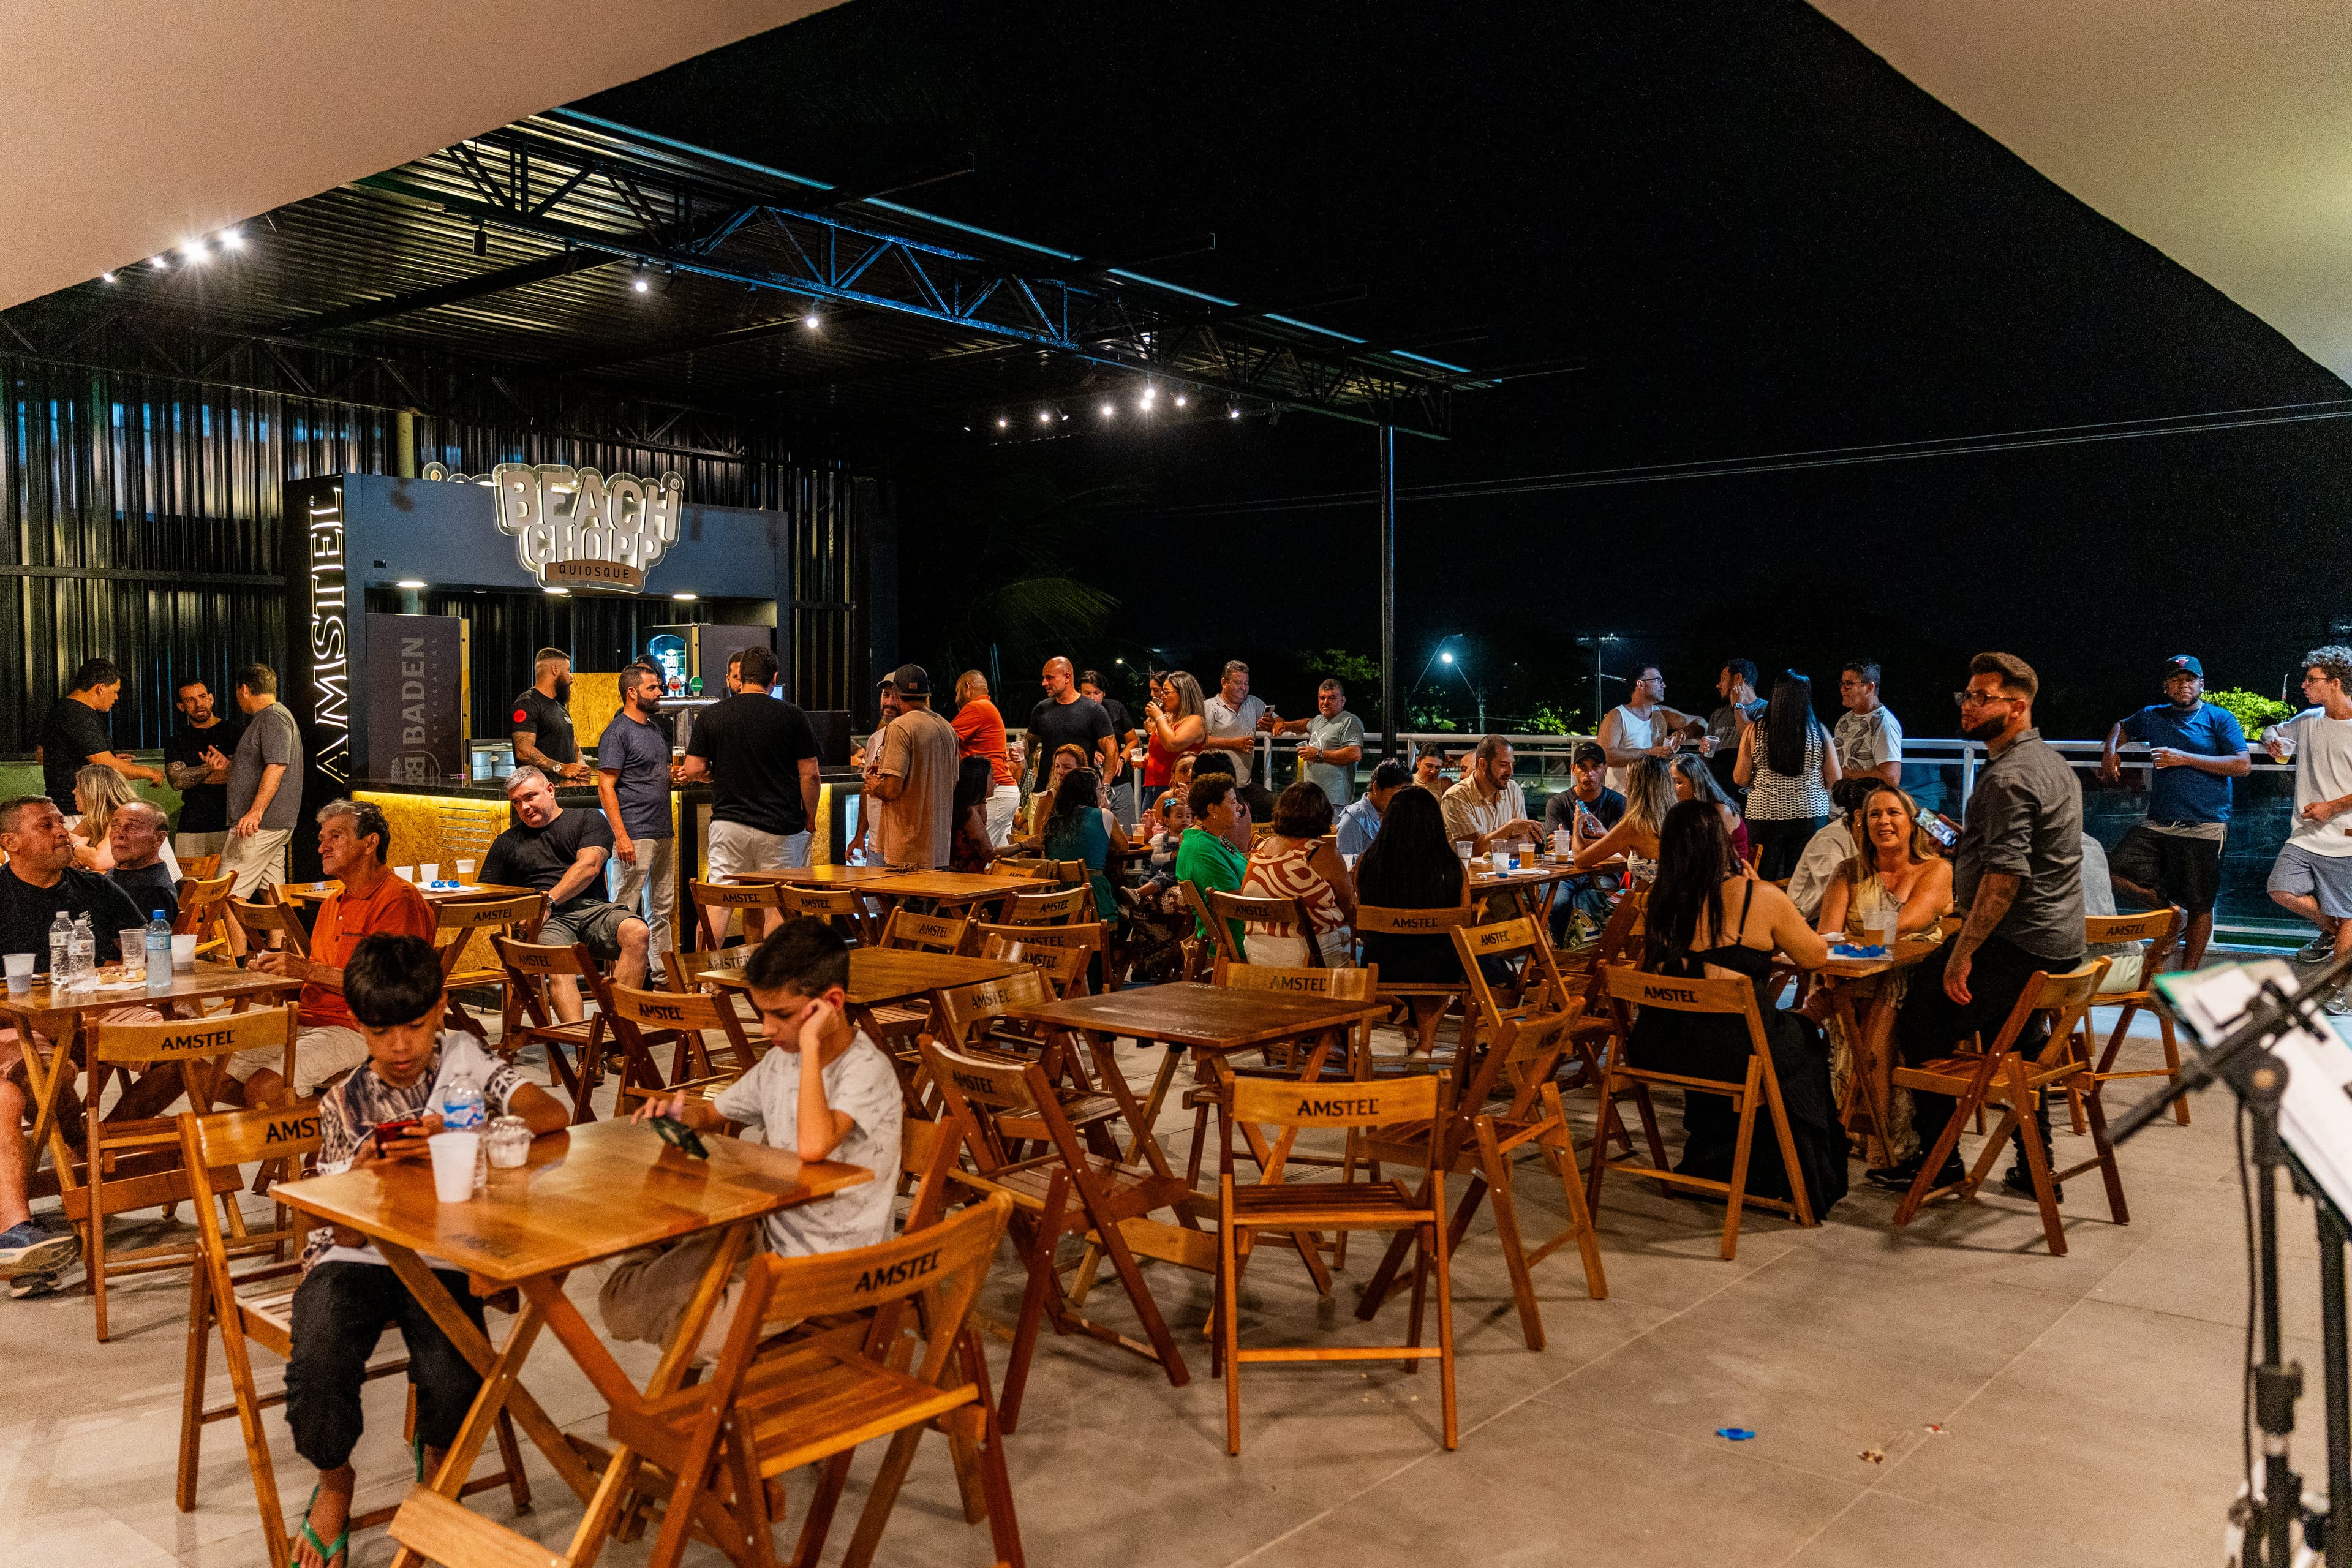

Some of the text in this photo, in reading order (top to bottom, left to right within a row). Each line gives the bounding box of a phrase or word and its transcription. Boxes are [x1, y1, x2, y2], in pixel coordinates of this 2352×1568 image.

[501, 472, 679, 541] BEACH
[528, 524, 662, 571] CHOPP
[559, 564, 630, 579] QUIOSQUE
[310, 487, 349, 783] AMSTEL
[402, 638, 426, 744] BADEN
[723, 894, 760, 903] AMSTEL
[801, 898, 831, 909] AMSTEL
[1039, 900, 1069, 913] AMSTEL
[473, 908, 513, 921] AMSTEL
[1235, 905, 1271, 916] AMSTEL
[919, 923, 948, 938] AMSTEL
[1392, 918, 1438, 928] AMSTEL
[2106, 924, 2146, 936] AMSTEL
[1480, 930, 1511, 946] AMSTEL
[519, 953, 551, 967] AMSTEL
[1021, 952, 1057, 968] AMSTEL
[1270, 976, 1327, 991] AMSTEL
[972, 989, 1011, 1010] AMSTEL
[1644, 986, 1698, 1003] AMSTEL
[639, 1003, 684, 1020] AMSTEL
[161, 1030, 236, 1050] AMSTEL
[953, 1069, 997, 1094] AMSTEL
[1297, 1098, 1379, 1117] AMSTEL
[266, 1117, 322, 1144] AMST
[853, 1248, 943, 1294] AMSTEL
